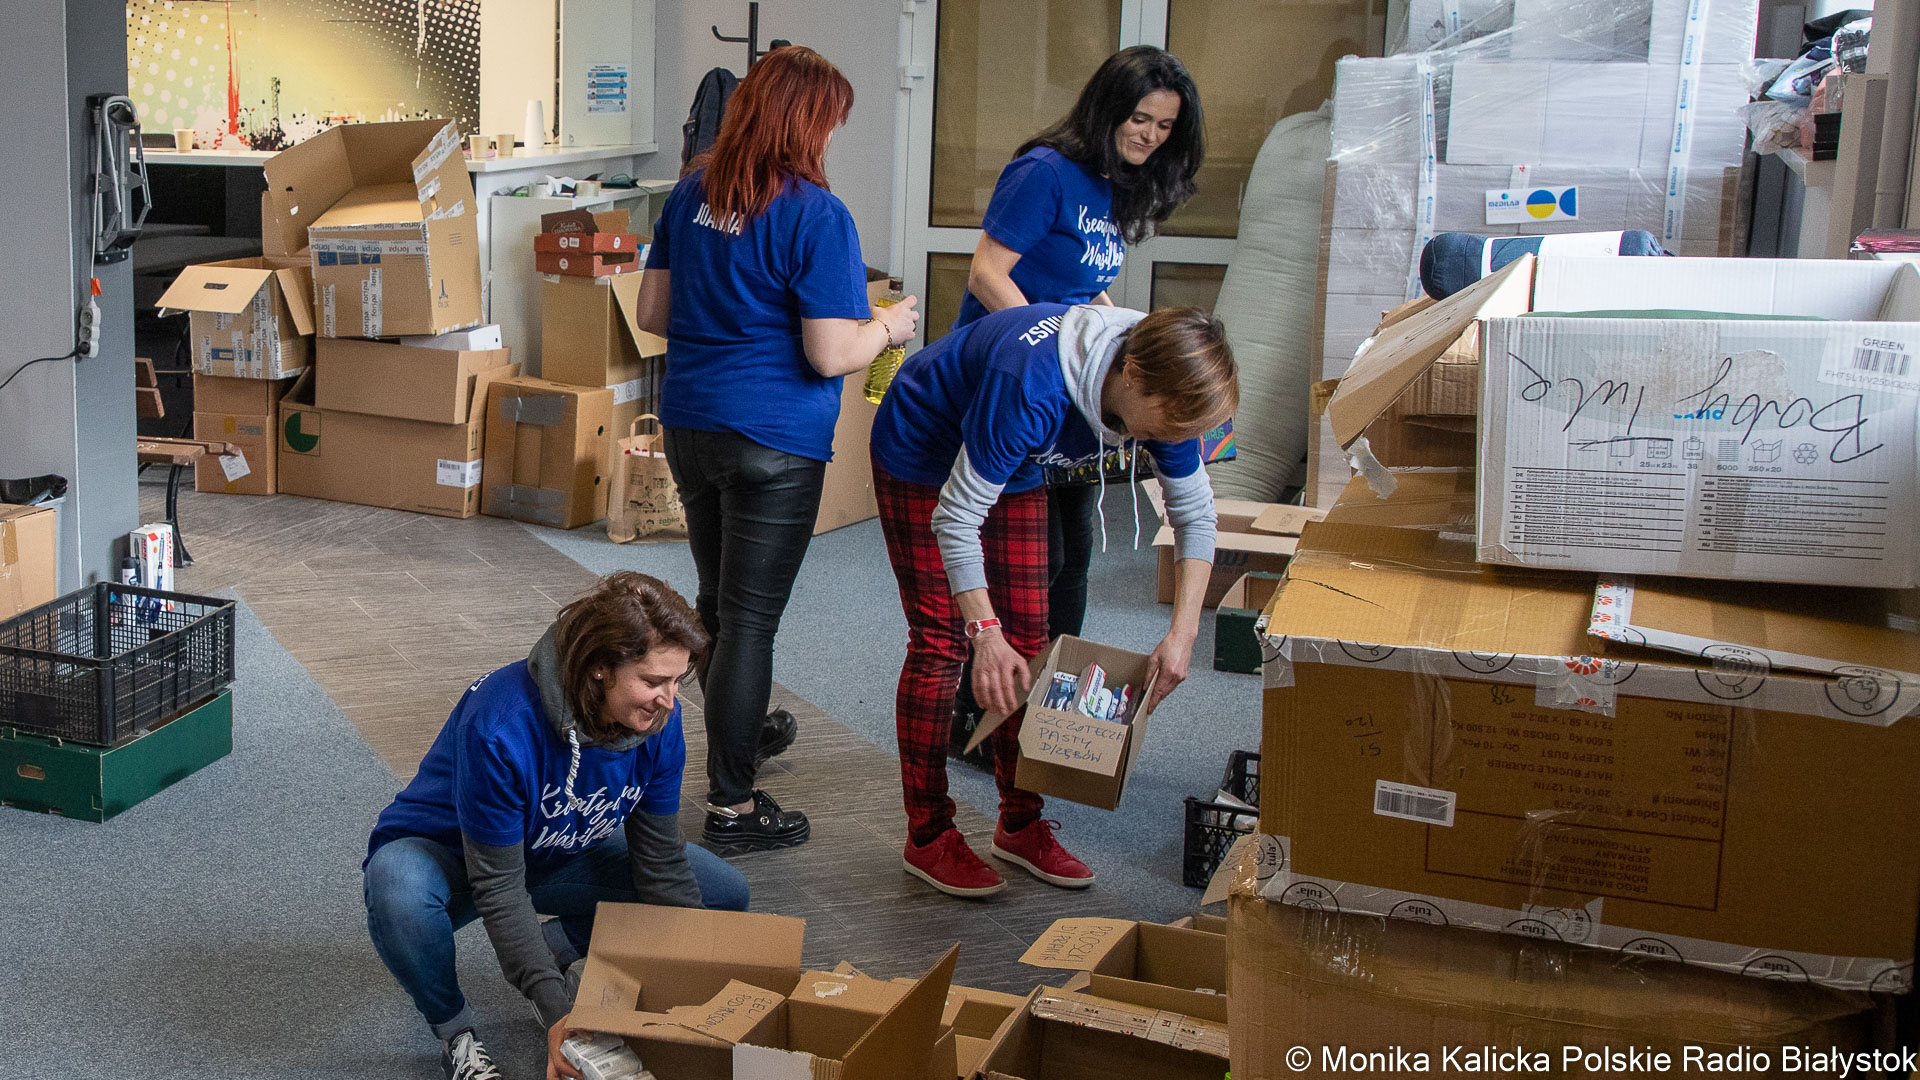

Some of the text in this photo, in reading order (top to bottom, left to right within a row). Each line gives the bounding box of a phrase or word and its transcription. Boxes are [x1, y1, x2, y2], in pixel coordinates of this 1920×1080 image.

[1863, 338, 1905, 351] GREEN
[1039, 727, 1092, 749] PASTY
[1521, 728, 1560, 741] GROSS
[1541, 749, 1568, 760] DUST
[1572, 752, 1614, 765] SLEEPY
[1487, 759, 1534, 773] CARRIER
[1537, 765, 1581, 778] BUCKLE
[1584, 769, 1613, 782] HALF
[1663, 795, 1721, 811] Shipment
[1637, 809, 1667, 821] Code
[1670, 812, 1719, 828] Product
[1560, 855, 1616, 869] HAMBURG
[1595, 850, 1650, 864] GERMANY
[1582, 878, 1613, 889] BABY
[1616, 883, 1648, 893] ERGO
